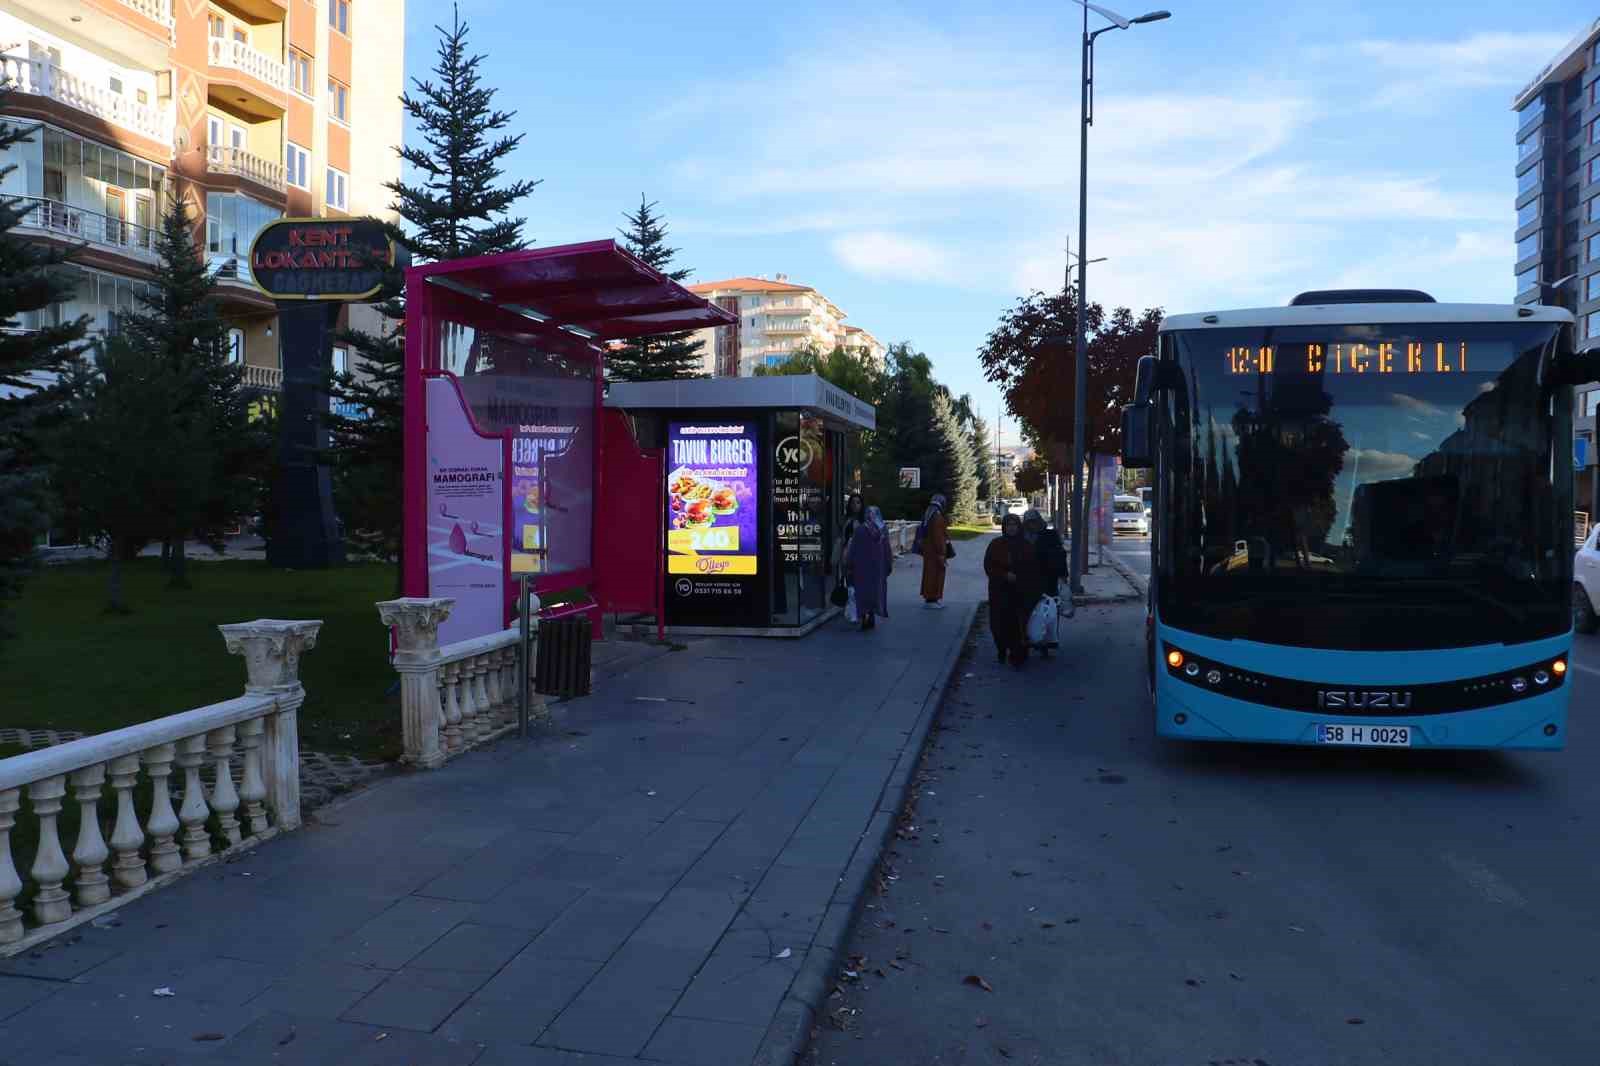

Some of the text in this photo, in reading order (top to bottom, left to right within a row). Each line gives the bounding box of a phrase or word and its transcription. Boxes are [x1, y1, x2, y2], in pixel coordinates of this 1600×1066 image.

[288, 227, 352, 247] KENT
[673, 438, 753, 465] TAVUK BURGER
[1316, 689, 1413, 708] ISUZU
[1326, 726, 1408, 743] 58 H 0029
